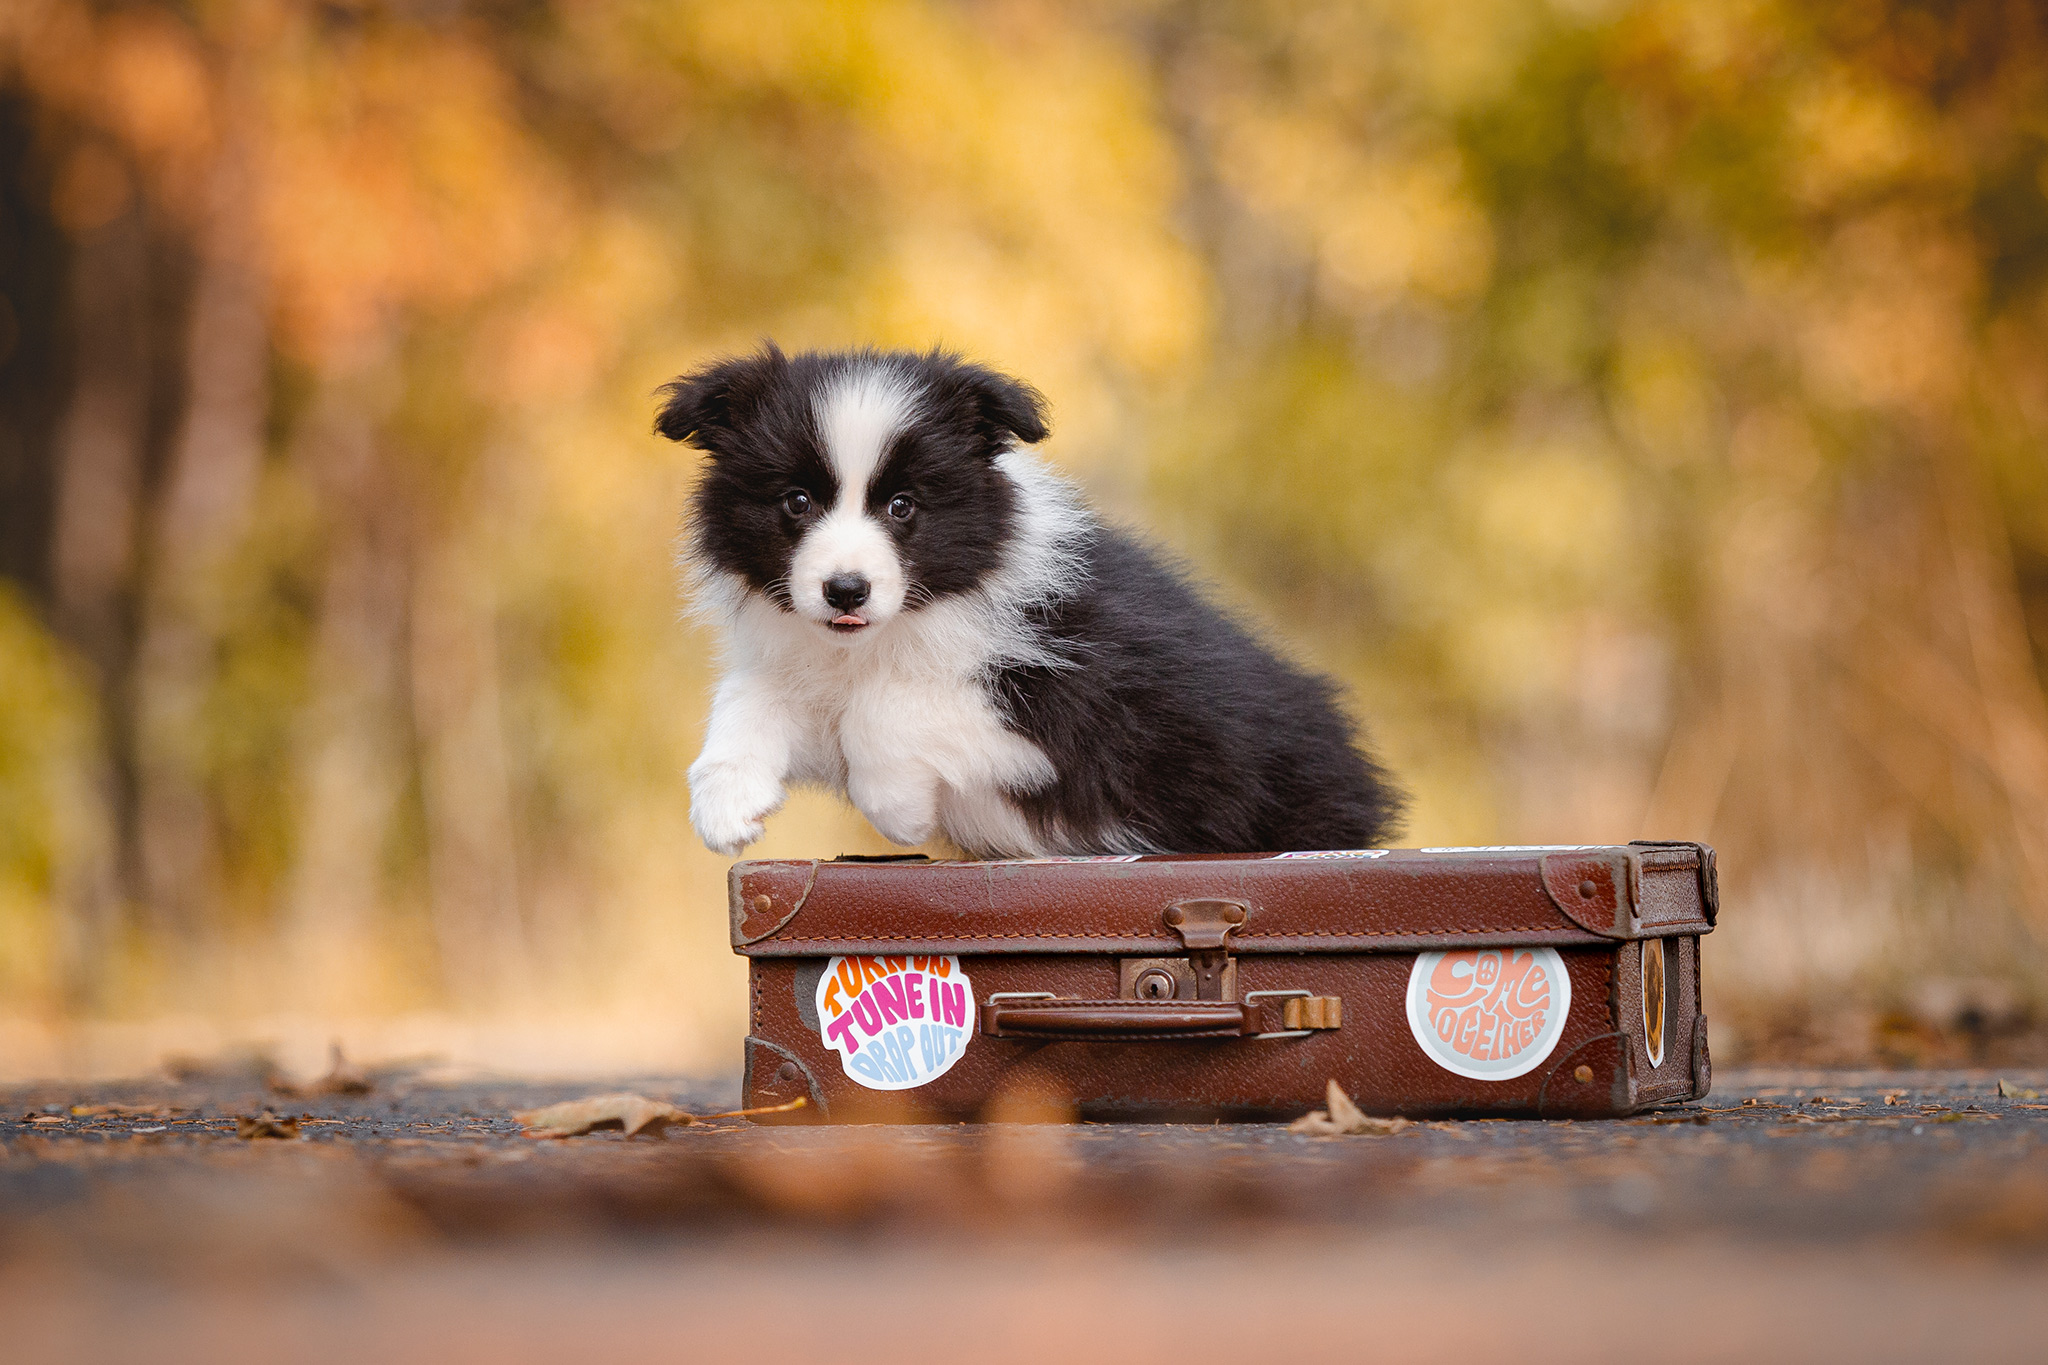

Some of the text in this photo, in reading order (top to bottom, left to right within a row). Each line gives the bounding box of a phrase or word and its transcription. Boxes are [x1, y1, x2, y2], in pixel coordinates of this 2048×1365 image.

[827, 973, 966, 1055] TUNE IN
[1426, 987, 1546, 1061] TOGETHER
[850, 1024, 963, 1083] DROP OUT
